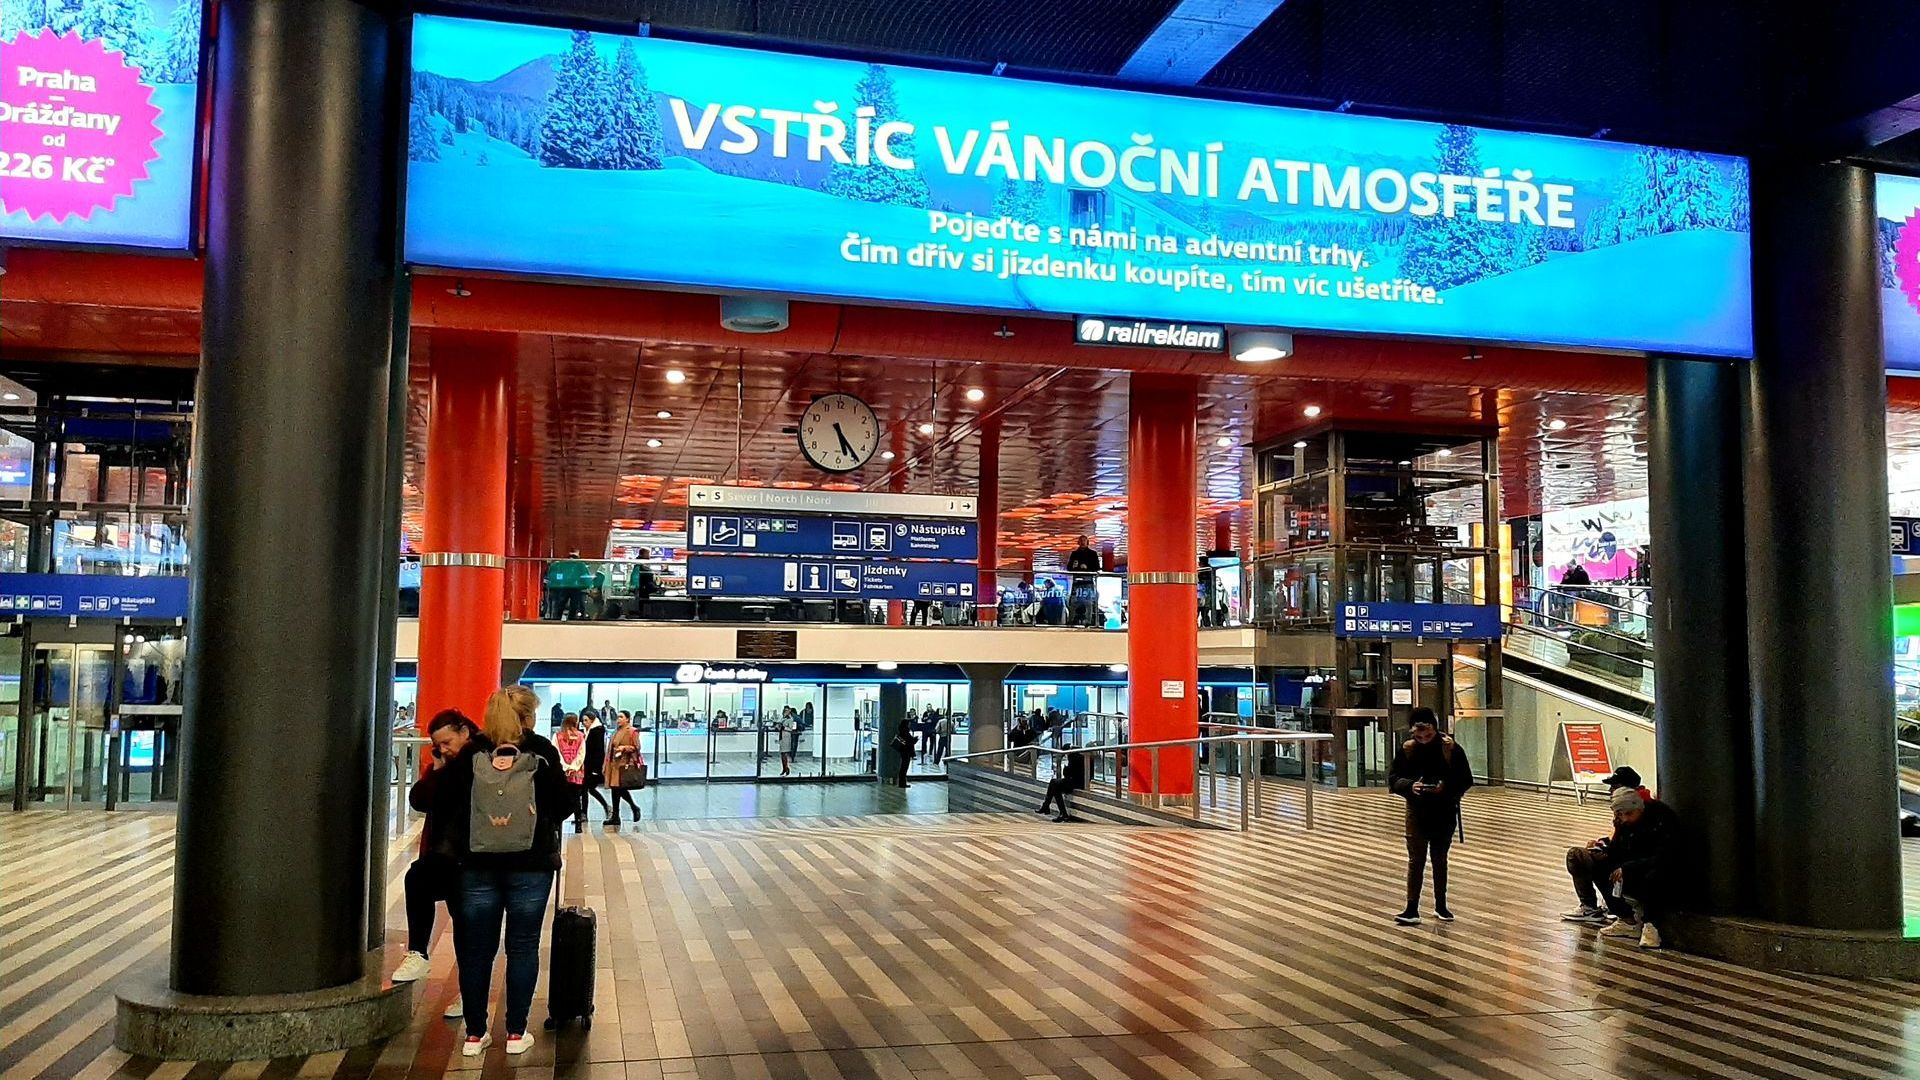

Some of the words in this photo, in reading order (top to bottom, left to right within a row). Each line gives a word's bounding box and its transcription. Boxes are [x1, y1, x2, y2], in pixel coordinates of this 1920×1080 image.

[17, 66, 97, 93] Praha
[42, 133, 66, 147] od
[670, 98, 915, 170] VSTŘÍC
[935, 121, 1223, 197] VÁNOČNÍ
[1236, 158, 1575, 229] ATMOSFÉŘE
[929, 211, 1041, 242] Pojeďte
[1049, 227, 1062, 244] s
[1070, 223, 1137, 250] námi
[1146, 236, 1178, 253] na
[1185, 235, 1303, 262] adventní
[1309, 243, 1370, 271] trhy.
[841, 231, 898, 264] Čím
[908, 242, 964, 269] dřív
[972, 252, 994, 272] si
[1000, 252, 1117, 280] jízdenku
[1125, 260, 1233, 293] koupíte,
[1242, 272, 1286, 293] tím
[1294, 275, 1329, 296] víc
[1337, 277, 1444, 305] ušetříte.
[1107, 322, 1220, 348] railreklam
[836, 400, 845, 409] 12
[812, 414, 821, 422] 10
[861, 416, 868, 424] 2
[807, 427, 814, 435] 9
[865, 431, 871, 439] 3
[811, 441, 818, 449] 8
[835, 456, 841, 464] 6
[714, 492, 721, 500] S
[766, 494, 798, 504] North
[806, 495, 832, 505] Nord
[948, 501, 954, 510] J
[911, 524, 966, 537] Nástupiště
[863, 565, 908, 578] Jízdenky
